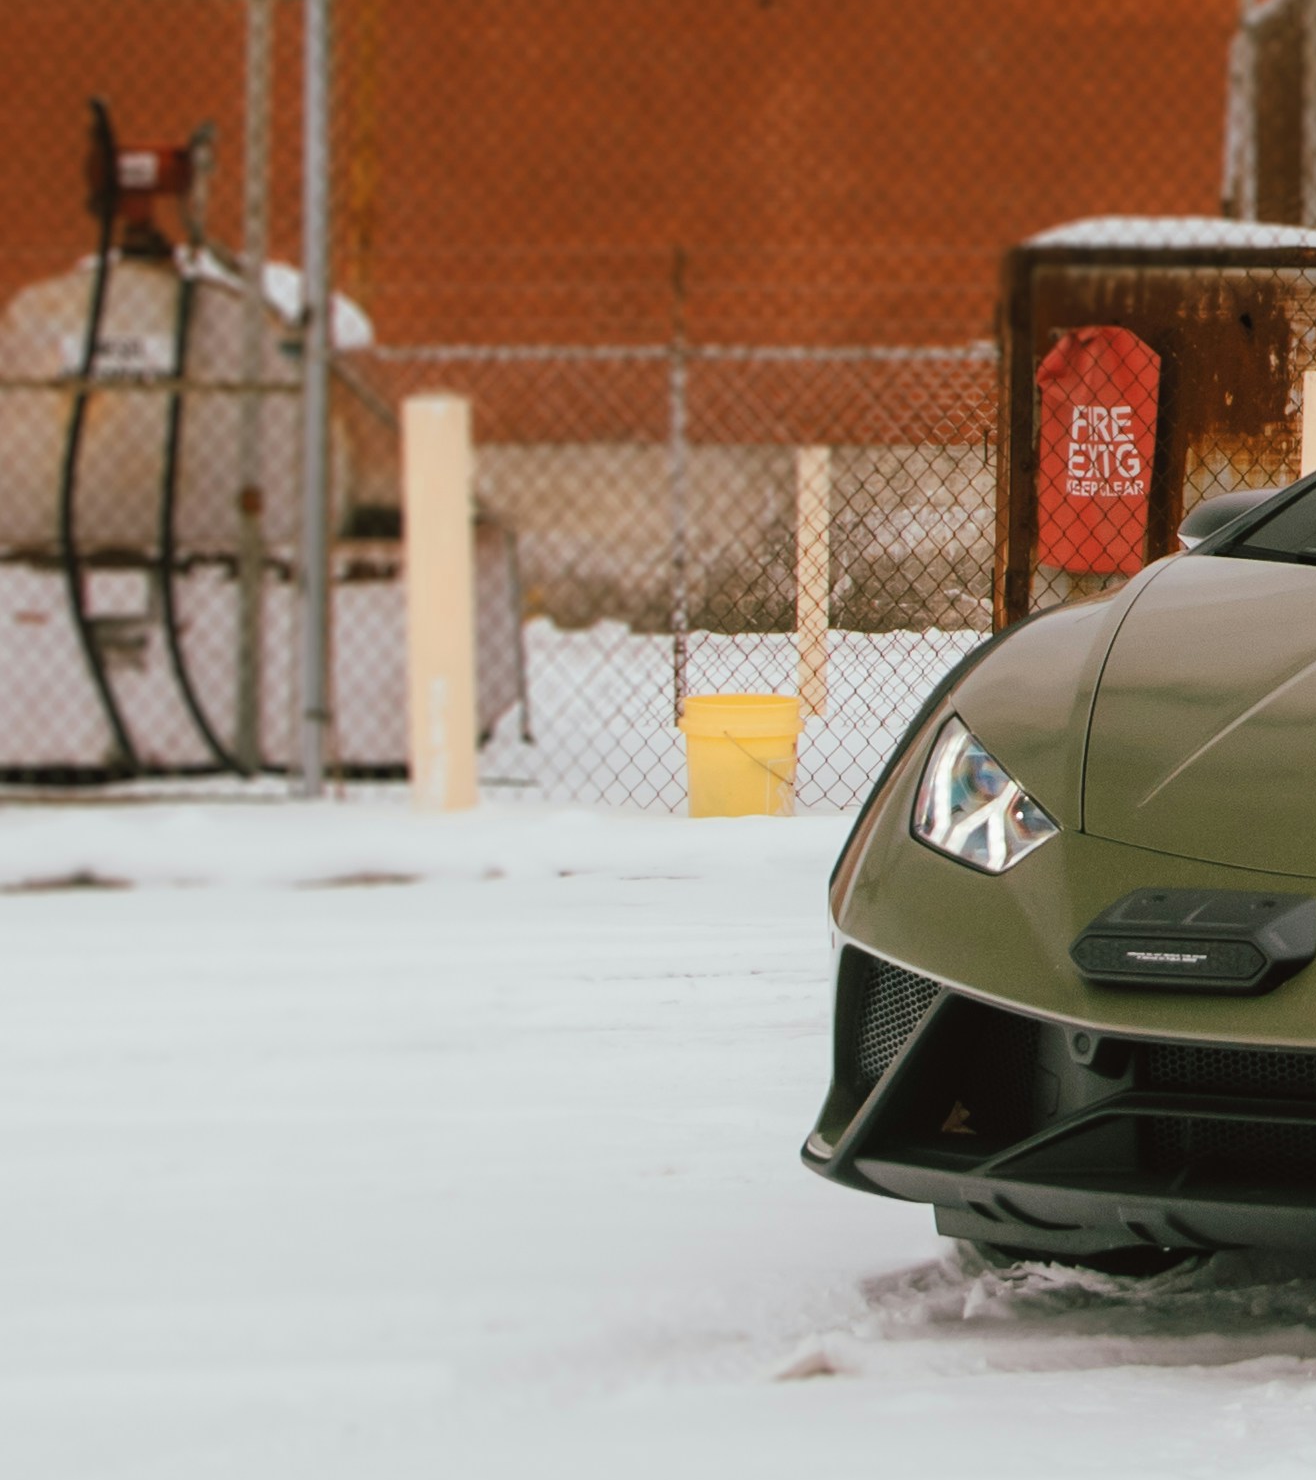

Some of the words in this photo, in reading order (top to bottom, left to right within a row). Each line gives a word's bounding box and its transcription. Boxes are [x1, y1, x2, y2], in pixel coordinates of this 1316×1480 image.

[1072, 405, 1134, 442] FIRE
[1068, 442, 1141, 479] EXTG
[1066, 479, 1098, 496] KEEP
[1099, 480, 1145, 496] CLEAR
